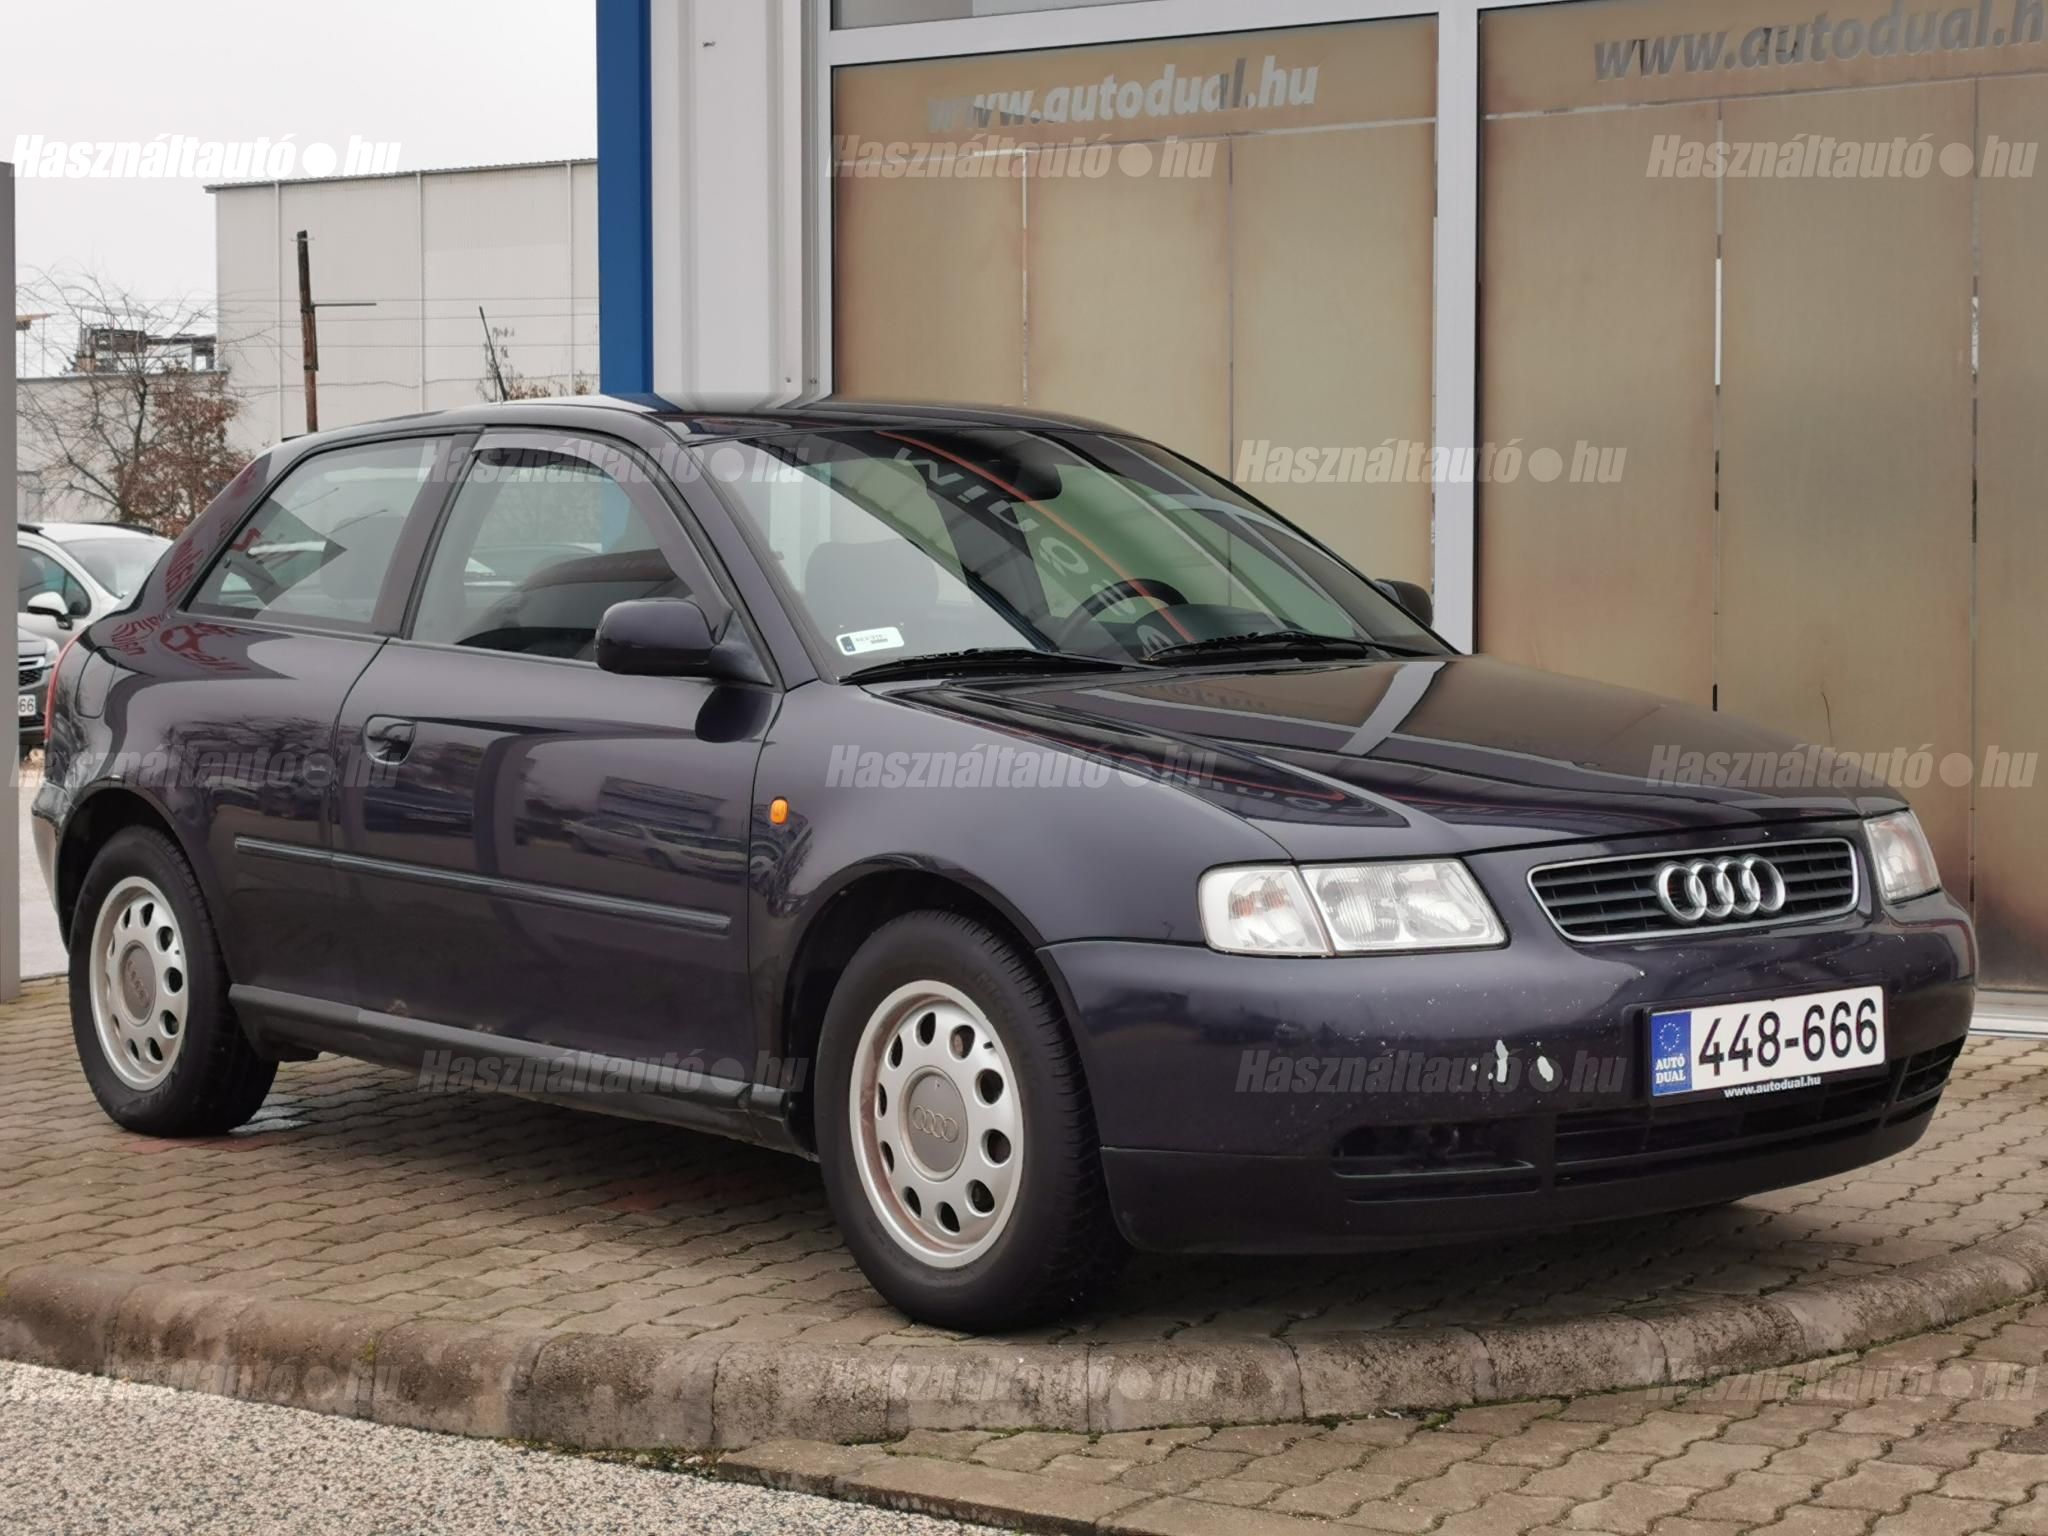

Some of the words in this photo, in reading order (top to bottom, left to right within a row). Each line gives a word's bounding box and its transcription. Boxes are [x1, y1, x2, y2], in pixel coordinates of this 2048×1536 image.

[927, 55, 1319, 131] www.autodual.hu
[1699, 998, 1877, 1076] 448-666
[1655, 1070, 1686, 1084] DUAL
[1724, 1075, 1821, 1098] www.autodual.hu
